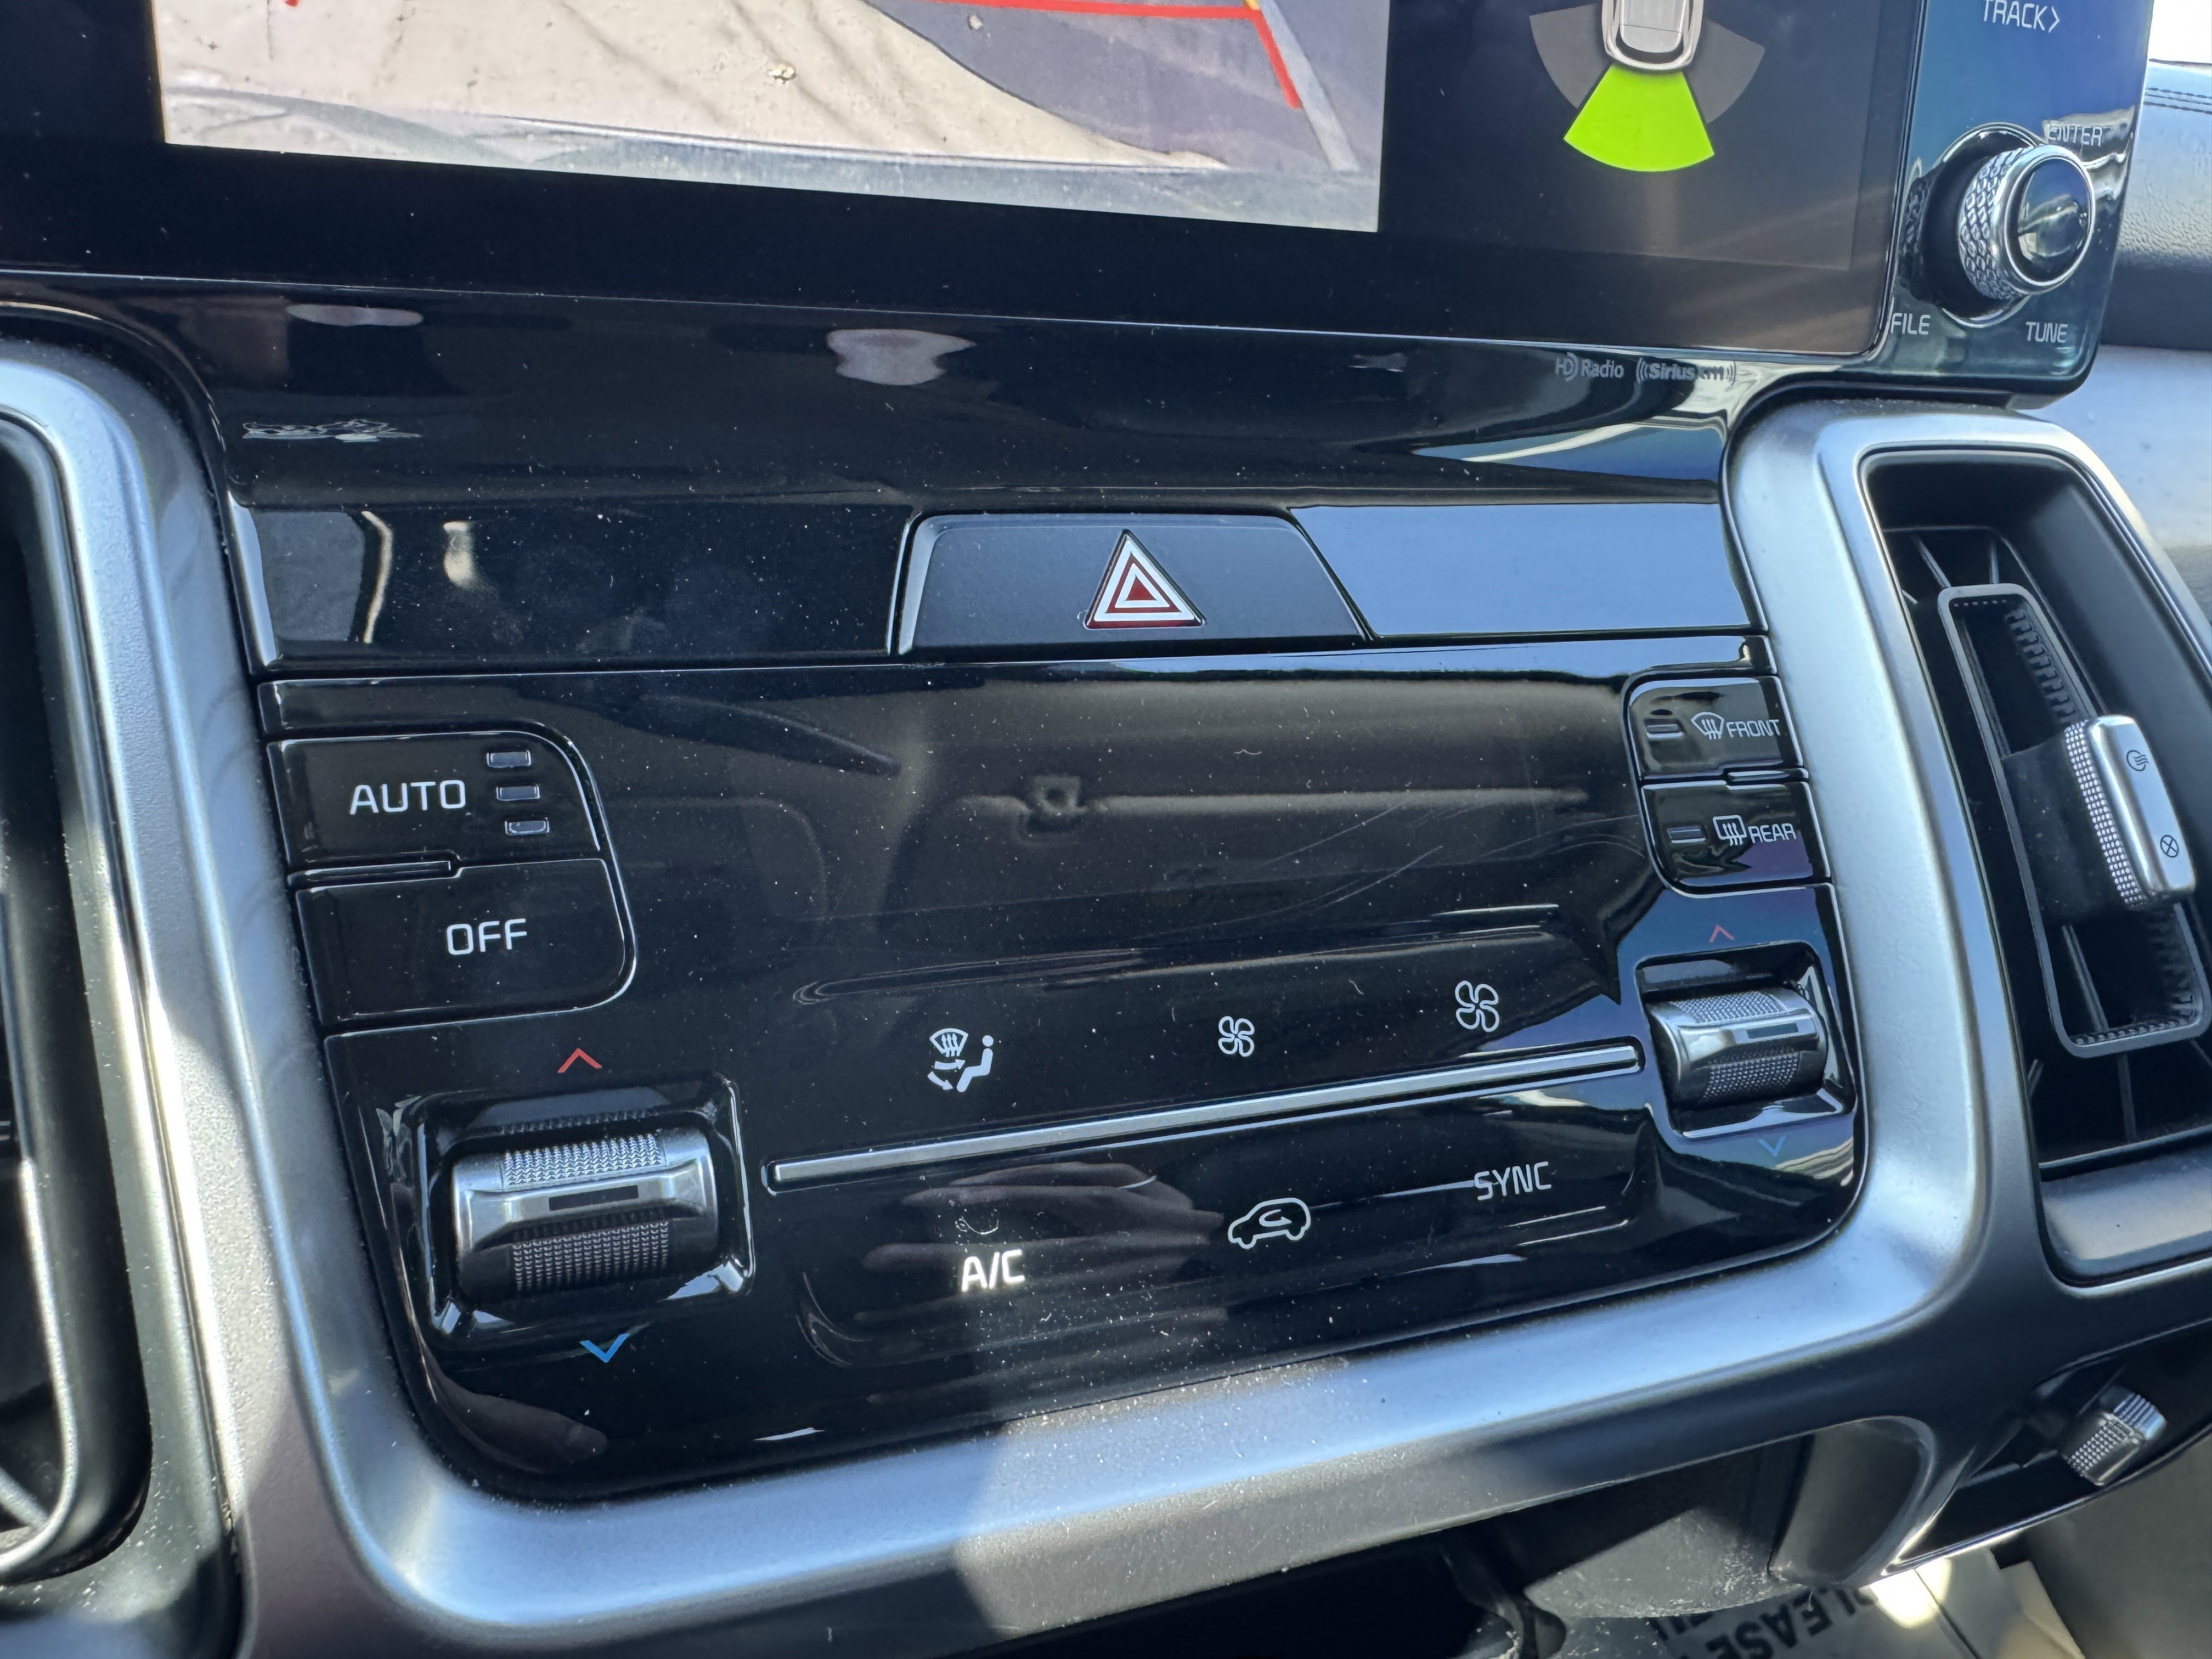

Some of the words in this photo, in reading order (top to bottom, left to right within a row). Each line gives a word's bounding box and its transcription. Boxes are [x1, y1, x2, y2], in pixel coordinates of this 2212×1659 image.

[1984, 0, 2047, 31] TRACK
[2045, 121, 2103, 146] ENTER
[1890, 312, 1931, 335] FILE
[2025, 321, 2068, 343] TUNE
[1581, 358, 1624, 378] Radio
[1726, 719, 1781, 737] FRONT
[349, 780, 466, 815] AUTO
[1748, 823, 1797, 843] REAR
[446, 918, 527, 955] OFF
[1474, 1161, 1552, 1201] SYNC
[961, 1248, 1025, 1293] A/C
